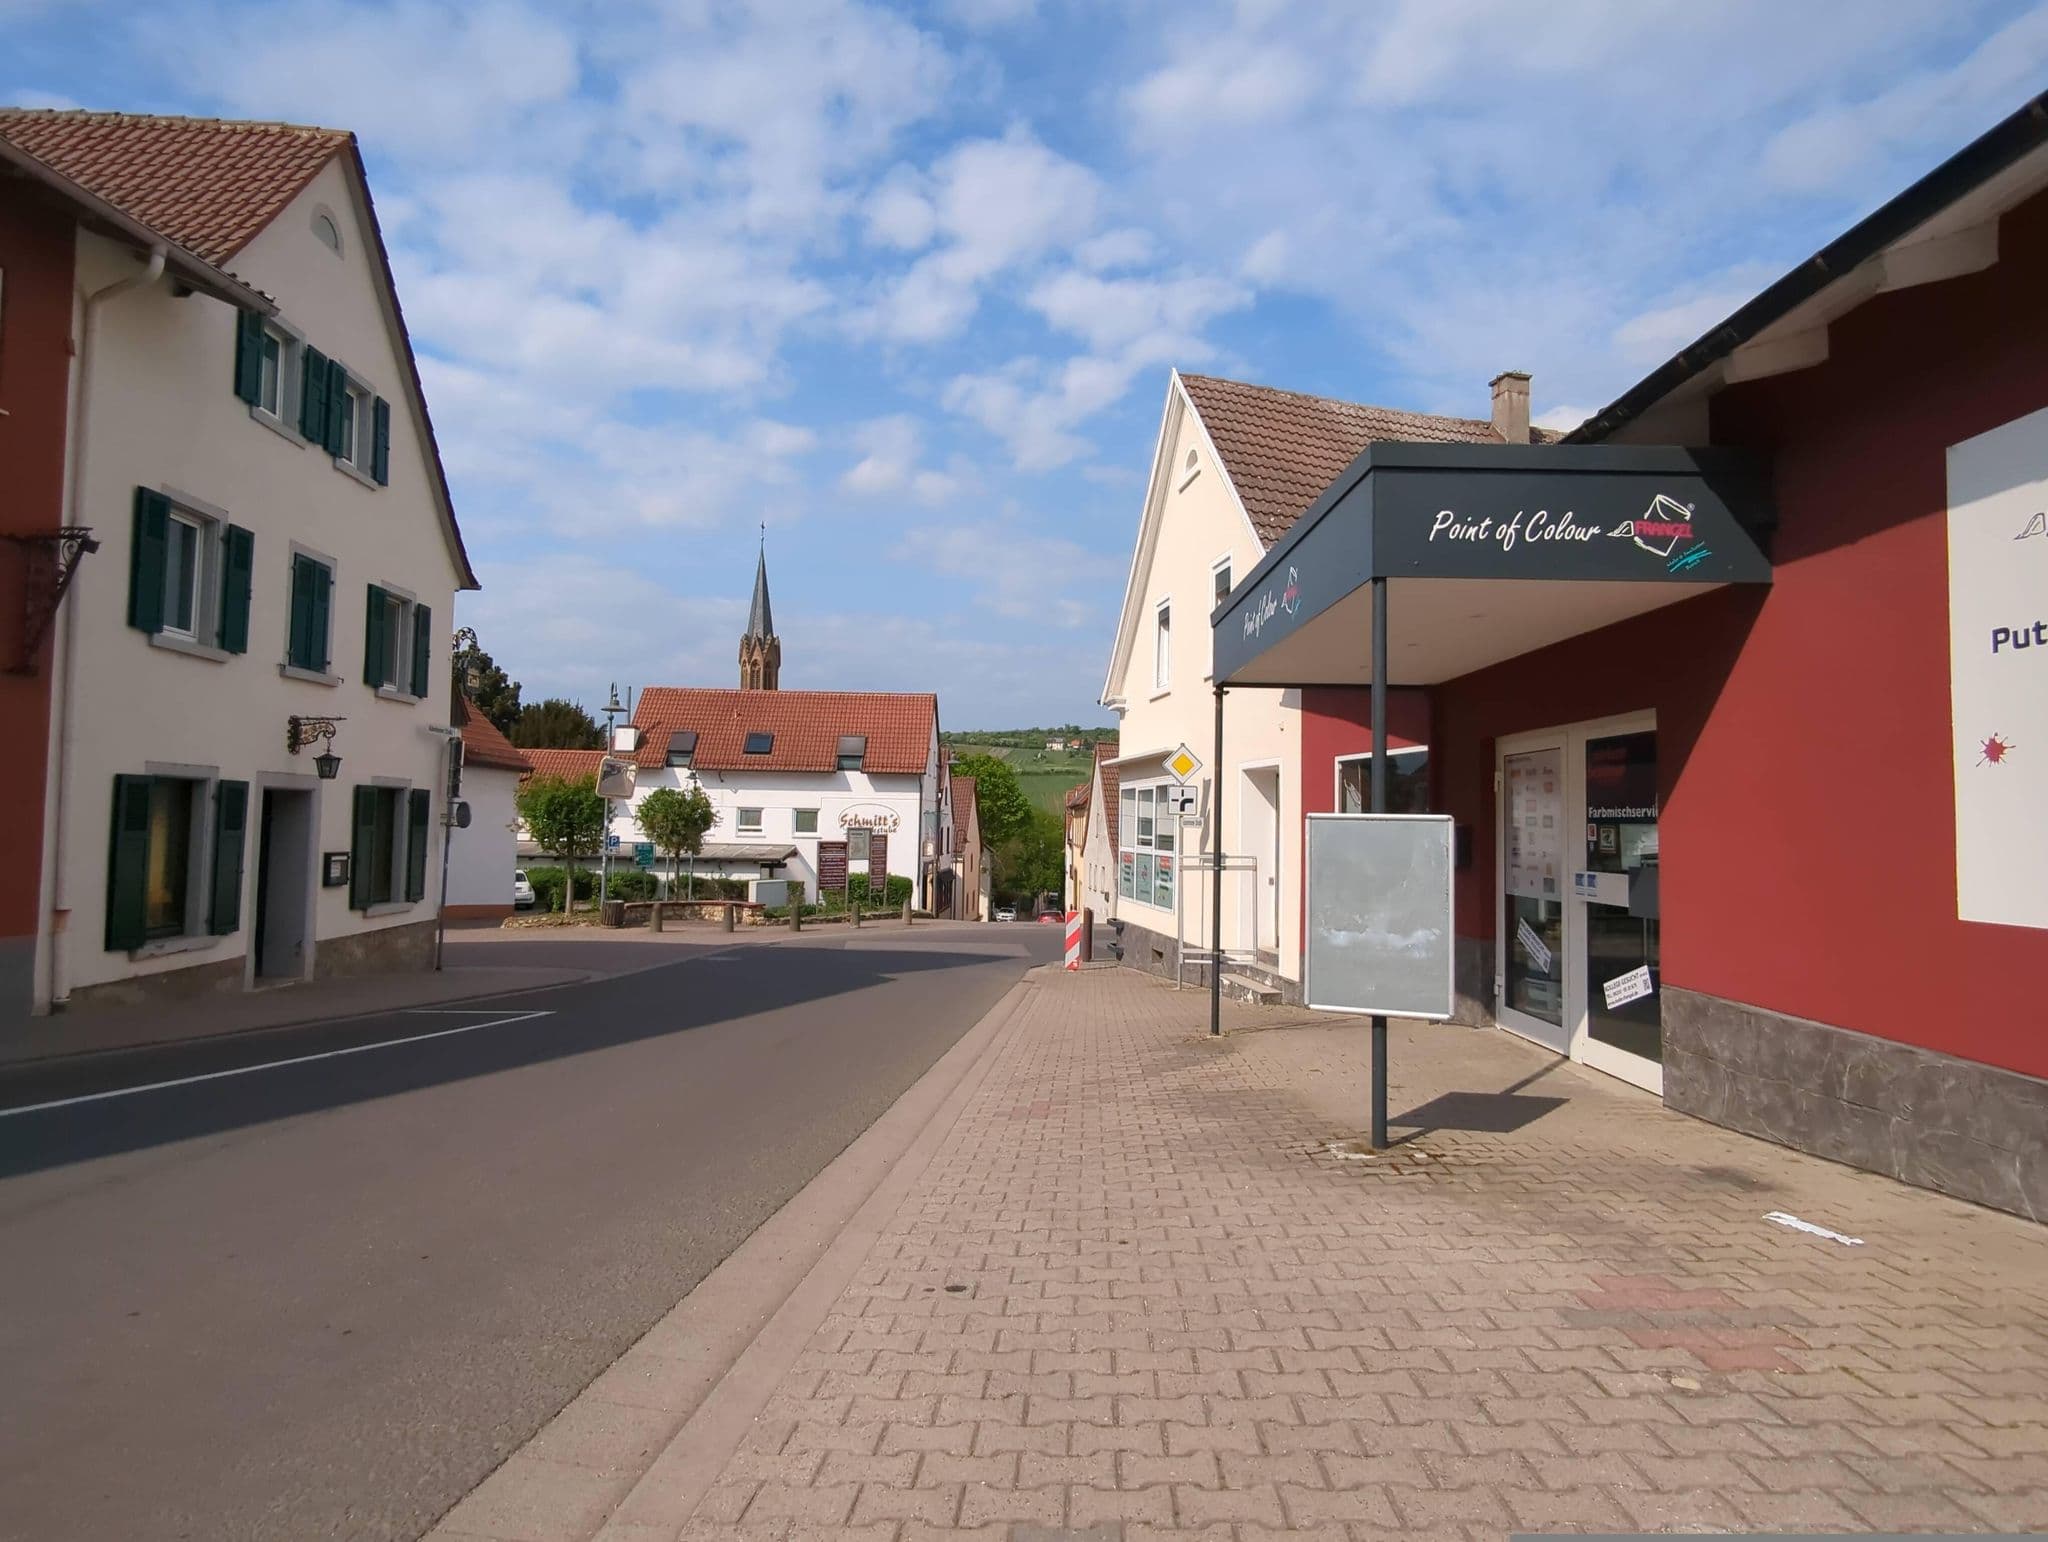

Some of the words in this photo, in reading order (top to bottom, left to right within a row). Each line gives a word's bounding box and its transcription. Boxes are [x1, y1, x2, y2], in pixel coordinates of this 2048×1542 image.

[1429, 510, 1492, 541] Point
[1495, 510, 1523, 551] of
[1525, 510, 1600, 542] Colour
[840, 813, 898, 828] Schmitt's
